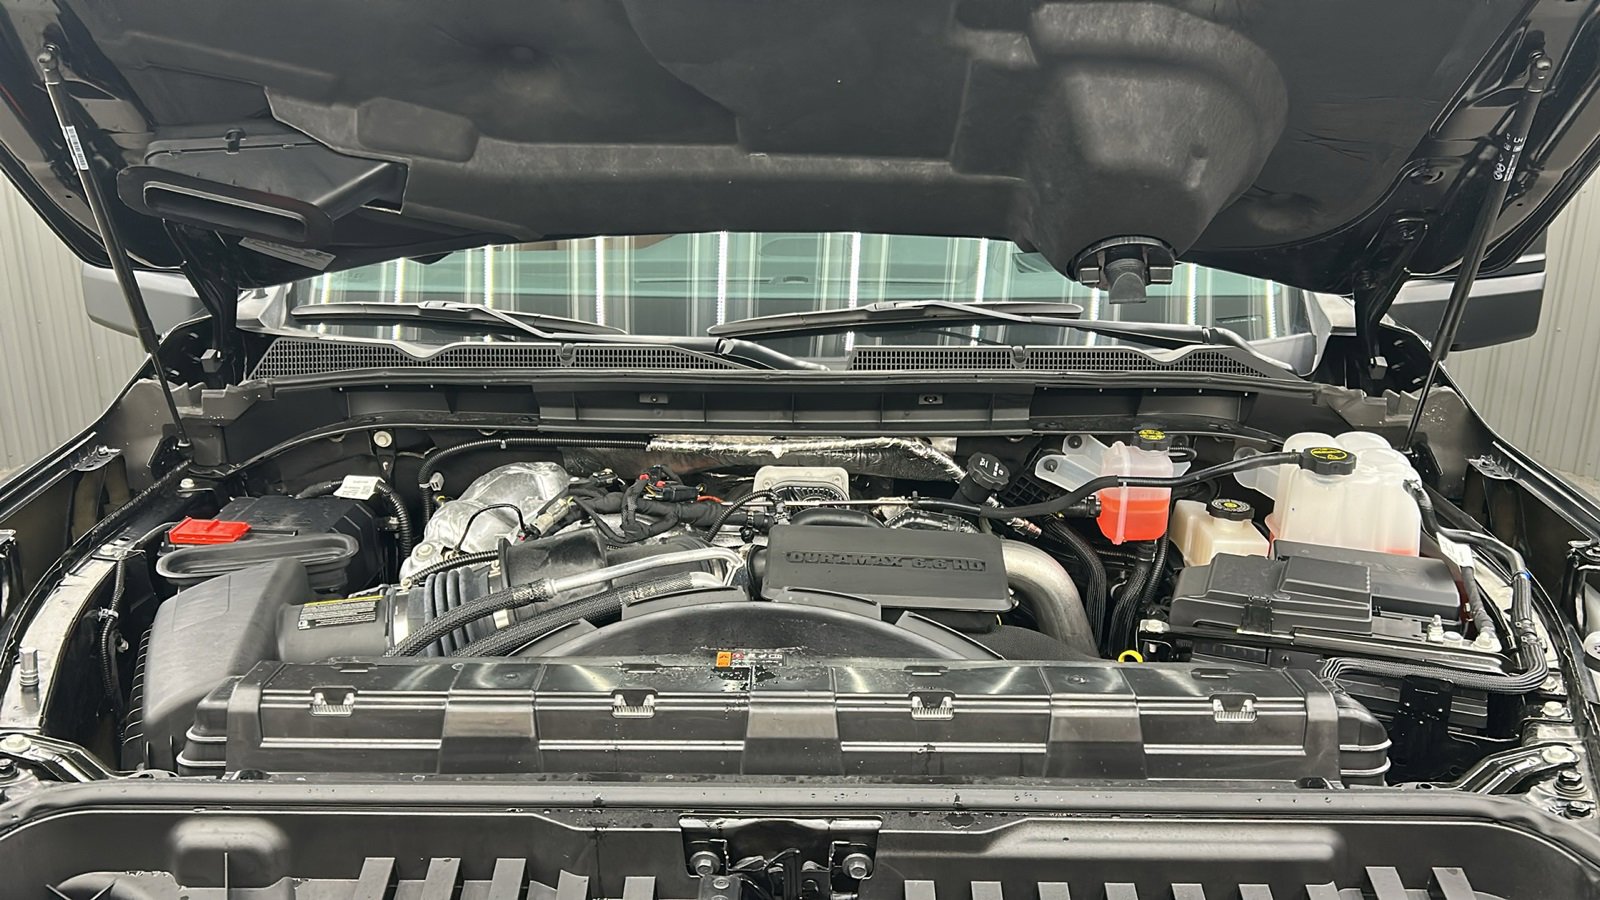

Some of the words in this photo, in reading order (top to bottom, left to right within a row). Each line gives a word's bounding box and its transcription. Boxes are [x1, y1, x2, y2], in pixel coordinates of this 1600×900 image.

[787, 551, 902, 567] DURAMAX
[912, 559, 947, 569] 6.6
[952, 560, 985, 571] HD
